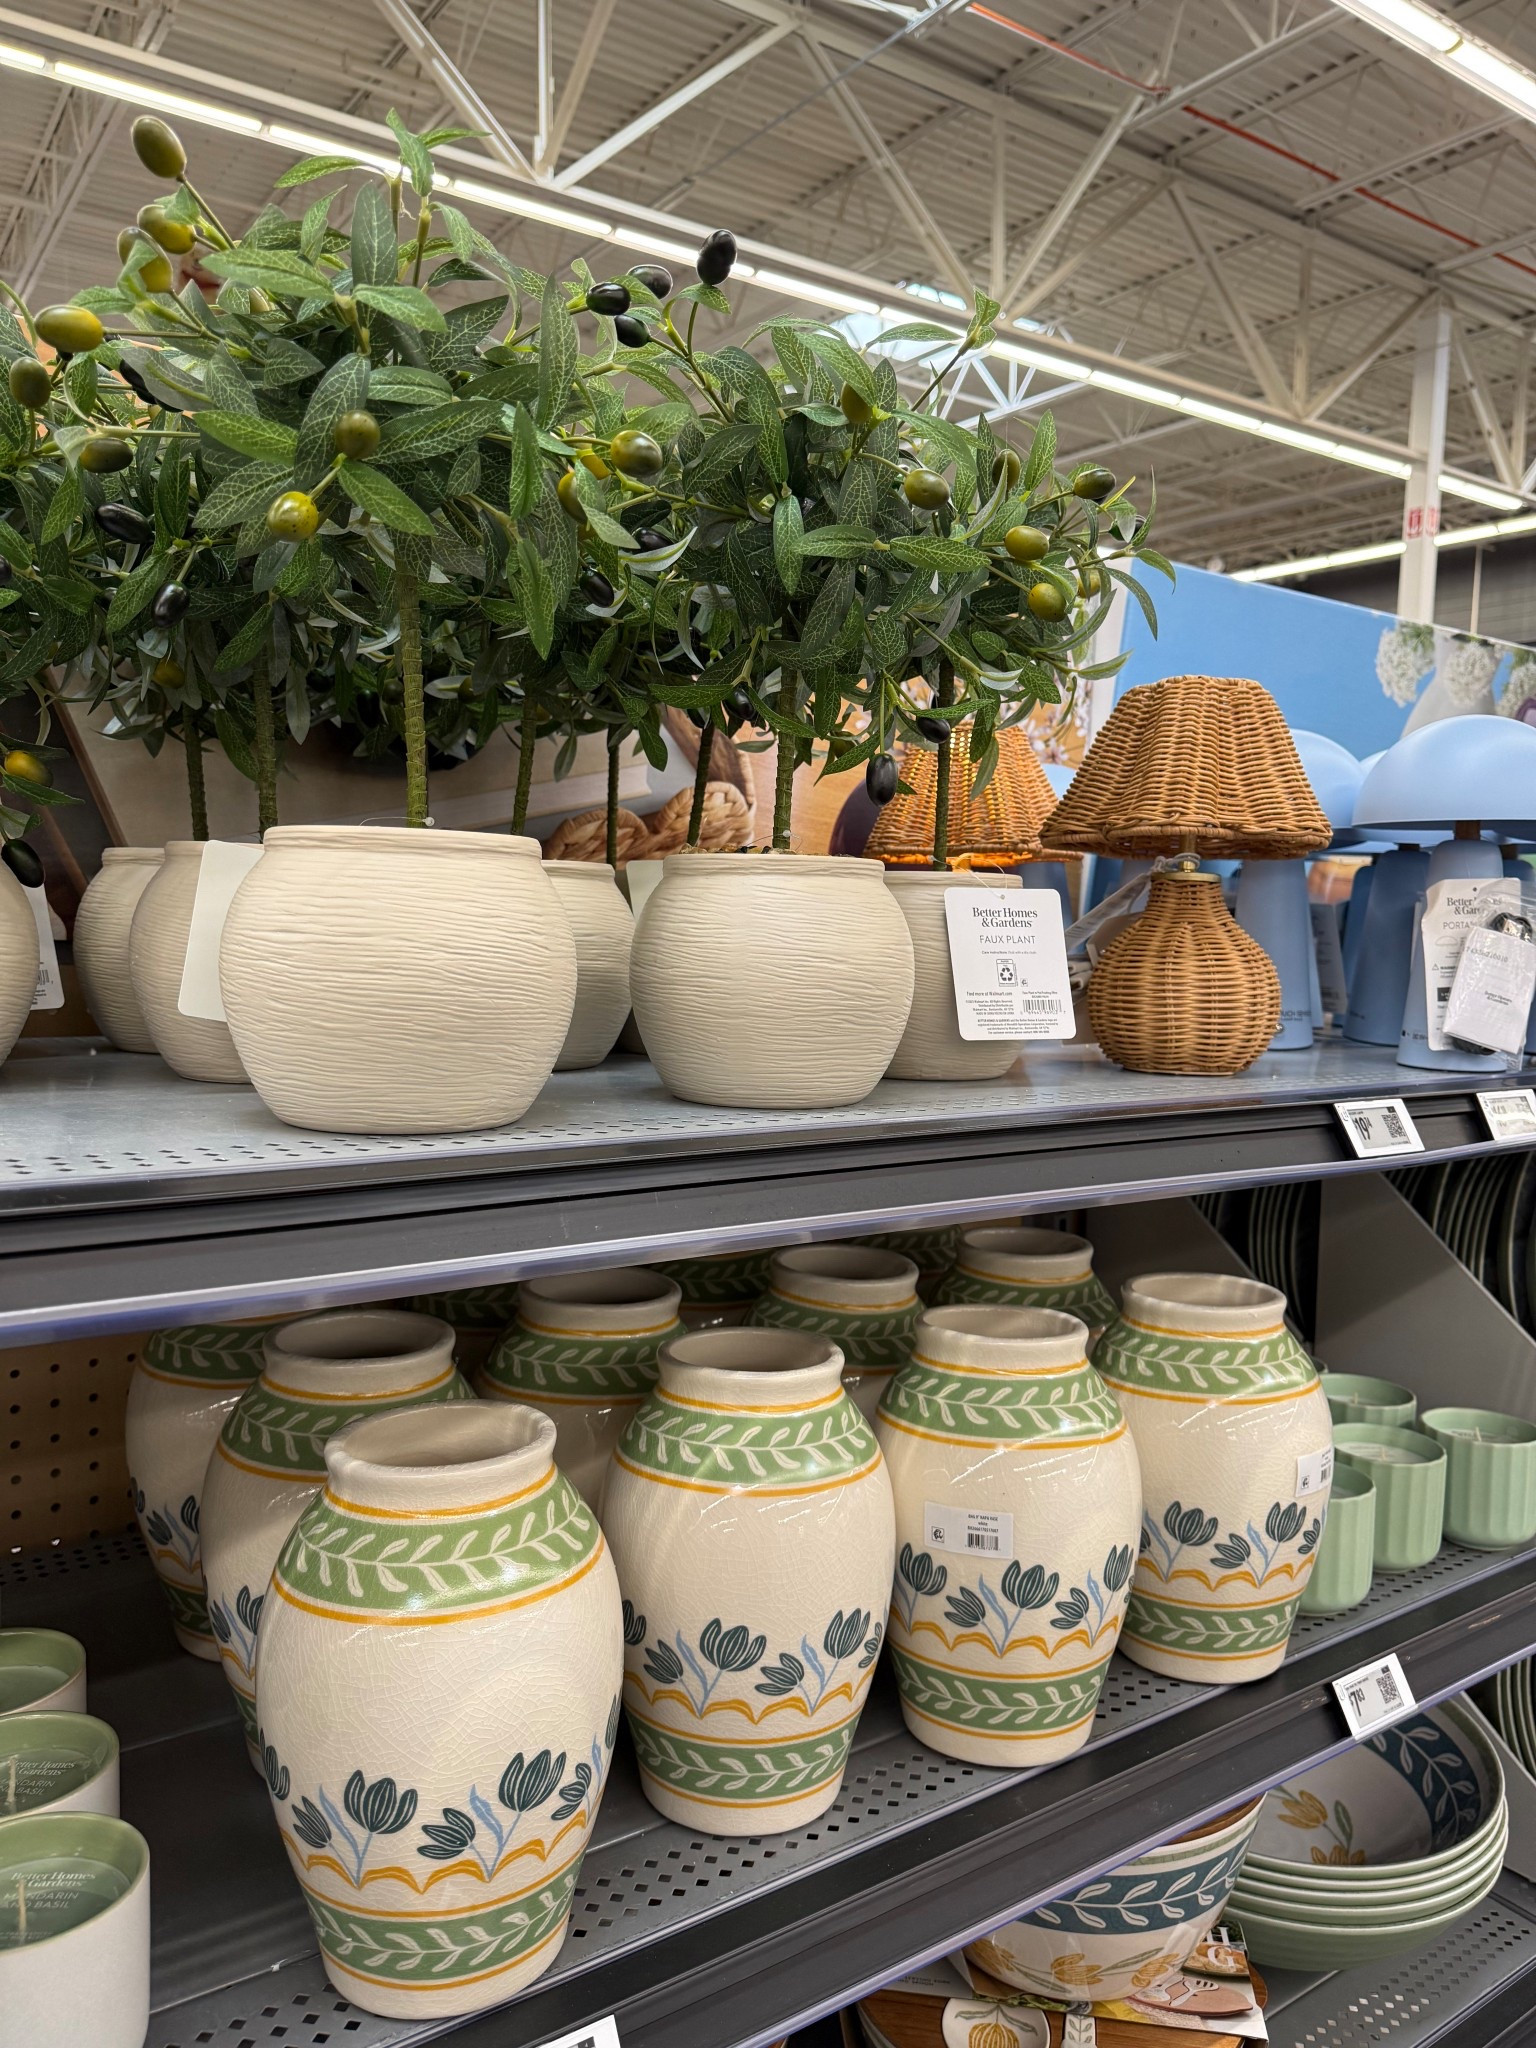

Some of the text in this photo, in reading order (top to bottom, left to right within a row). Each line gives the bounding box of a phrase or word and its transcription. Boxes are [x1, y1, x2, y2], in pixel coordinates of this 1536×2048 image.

[1447, 897, 1473, 907] Better
[972, 907, 1038, 918] Better Homes
[979, 935, 1036, 944] FAUX PLANT
[15, 1760, 76, 1769] etter Homes
[19, 1768, 63, 1776] Gardens
[16, 1787, 45, 1795] BASIL
[11, 1871, 96, 1881] Better Homes
[28, 1879, 83, 1888] Gardens
[34, 1900, 70, 1909] BASIL
